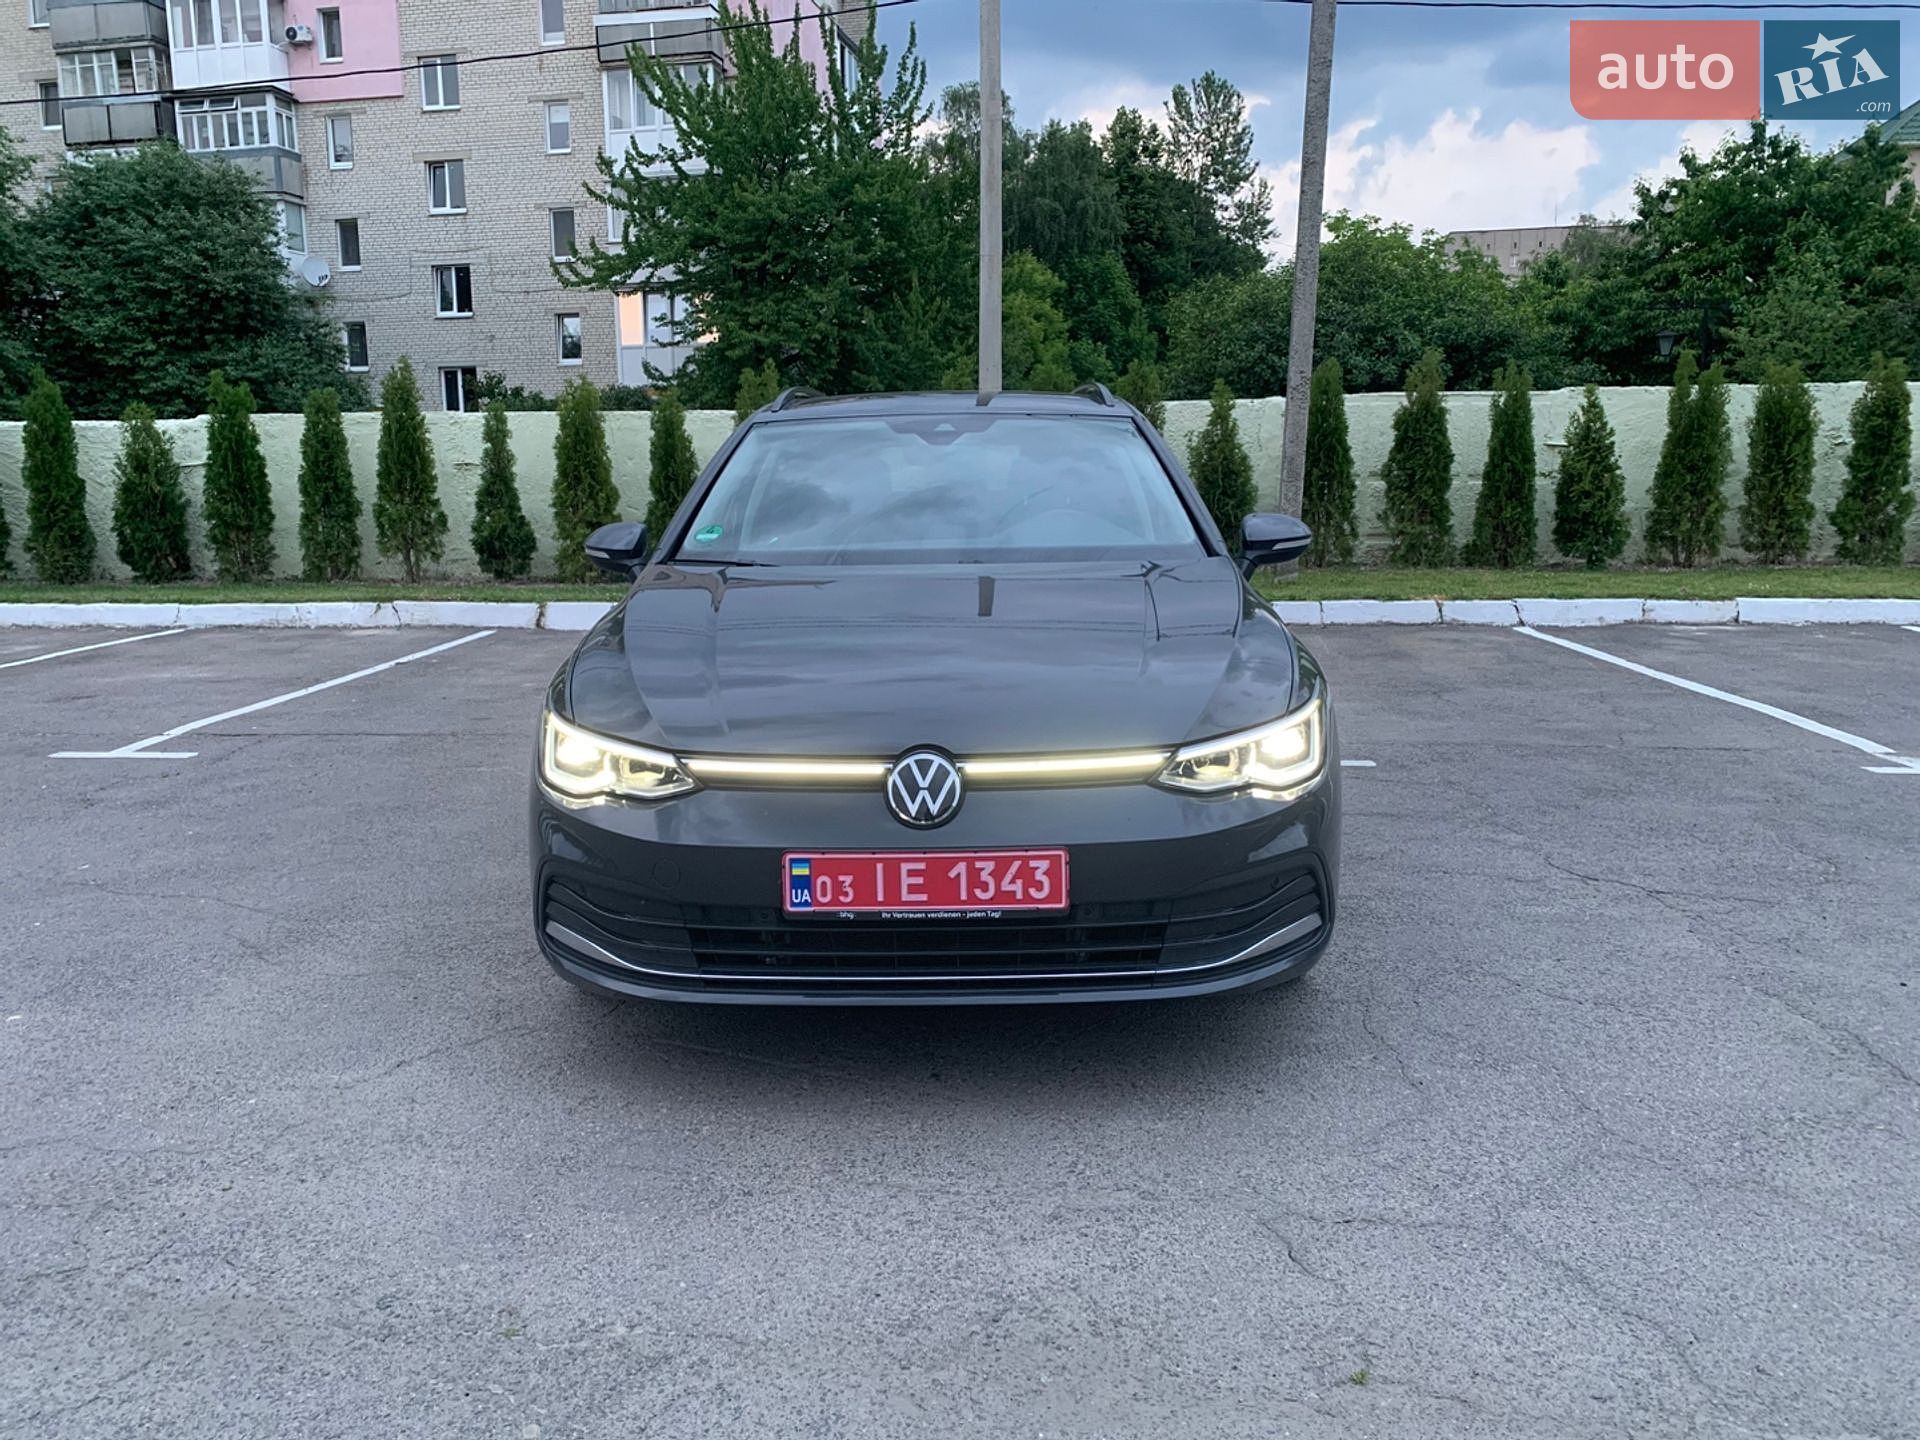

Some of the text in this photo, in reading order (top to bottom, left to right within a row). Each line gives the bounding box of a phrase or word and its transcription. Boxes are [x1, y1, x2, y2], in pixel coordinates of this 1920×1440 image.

[815, 860, 1051, 903] 03 IE 1343
[791, 889, 811, 903] UA
